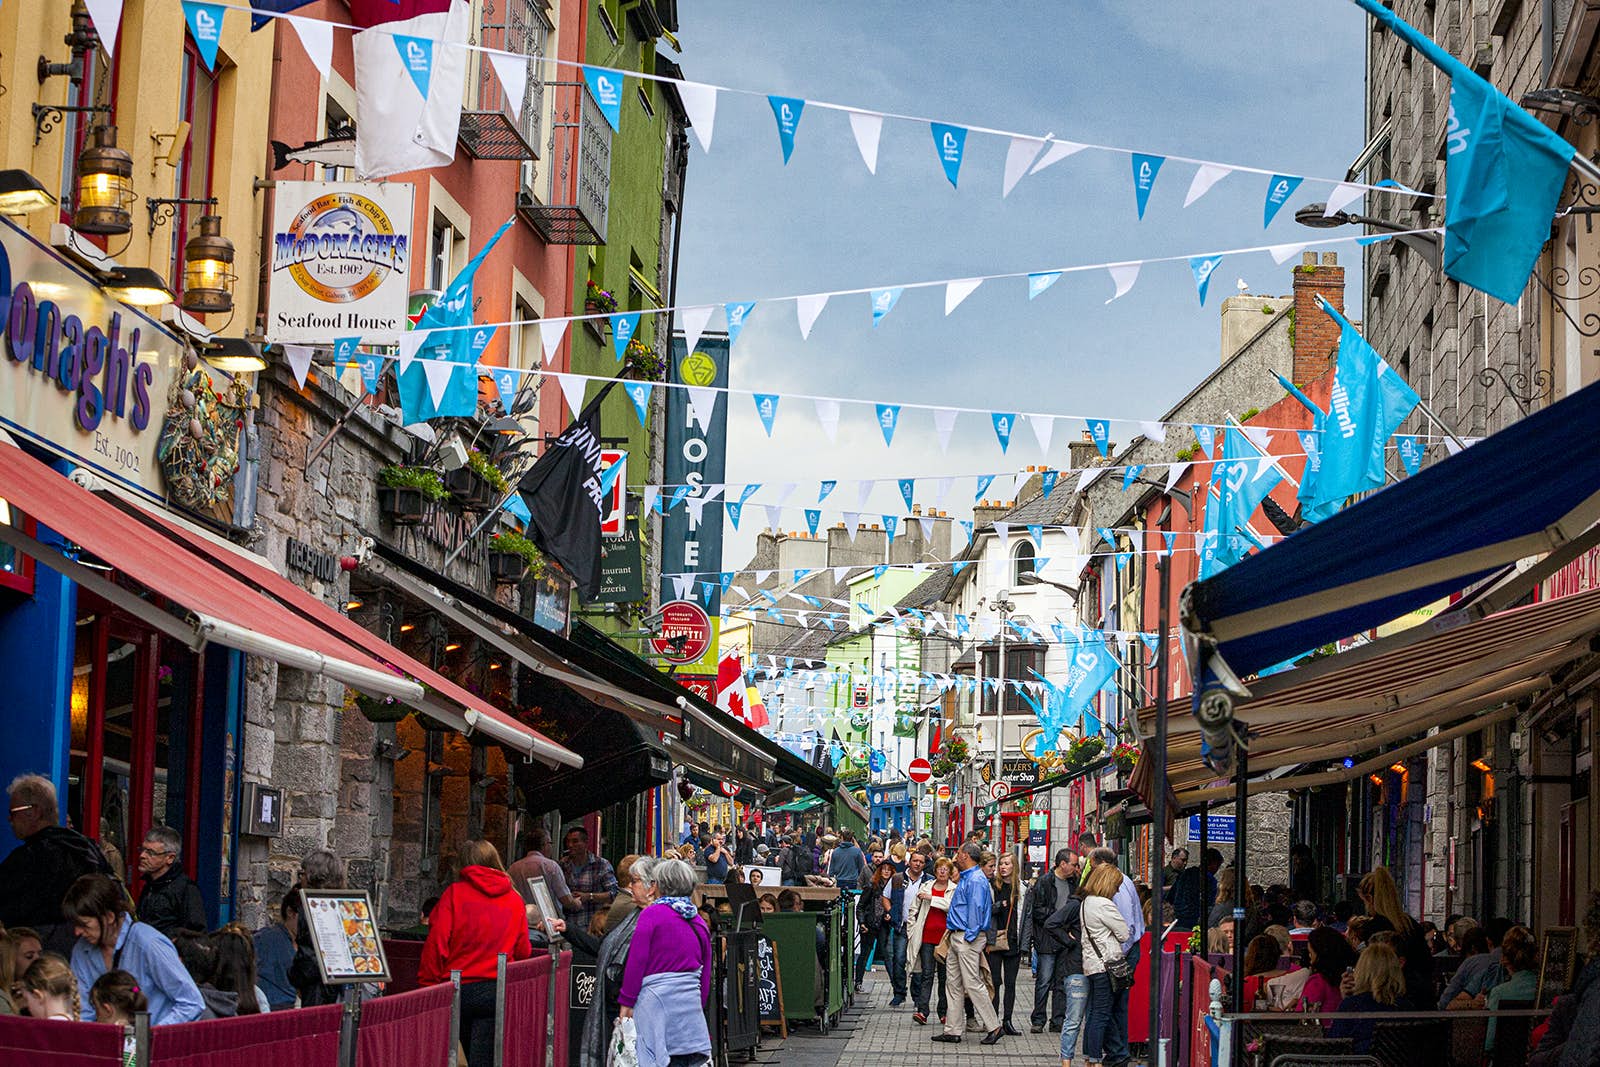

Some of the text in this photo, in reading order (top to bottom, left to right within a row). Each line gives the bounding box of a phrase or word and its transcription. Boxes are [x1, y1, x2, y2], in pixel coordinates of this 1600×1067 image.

[292, 196, 390, 232] Seafood Bar Fish & Chip Bar
[273, 232, 408, 275] McDONAGH'S
[316, 263, 363, 275] Est. 1902
[277, 311, 397, 330] Seafood House
[94, 430, 141, 473] Est. 1902
[286, 537, 336, 583] RECEPTION
[600, 584, 627, 594] izzeria
[1002, 758, 1032, 772] ALLER'S
[1002, 772, 1035, 783] eater Shop
